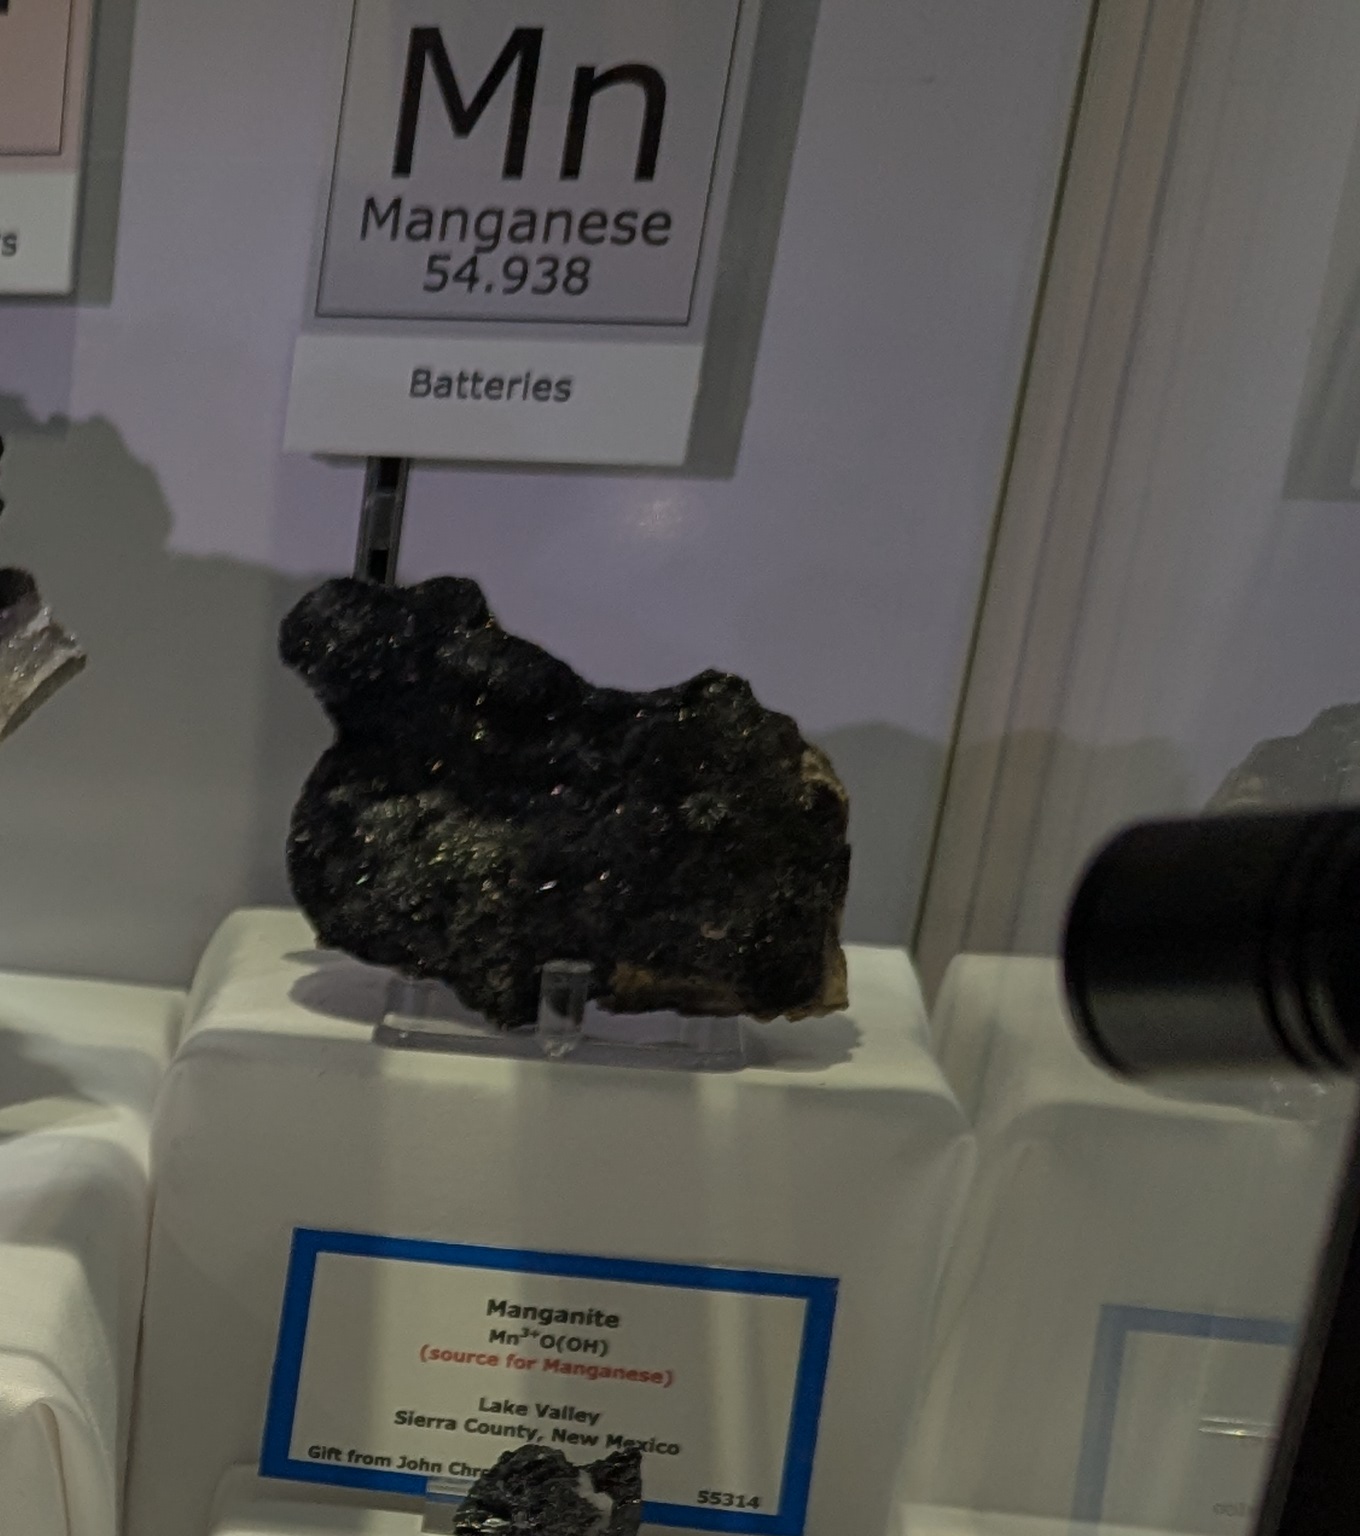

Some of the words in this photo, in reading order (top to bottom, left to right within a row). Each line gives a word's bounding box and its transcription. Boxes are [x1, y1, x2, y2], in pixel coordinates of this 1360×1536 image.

[392, 26, 667, 183] Mn
[360, 195, 673, 255] Manganese
[422, 251, 592, 296] 54.938
[409, 367, 573, 403] Batteries
[486, 1298, 620, 1329] Manganite
[419, 1343, 500, 1367] (source
[505, 1352, 538, 1370] for
[542, 1358, 673, 1388] Manganese)
[393, 1409, 458, 1431] Sierra
[463, 1417, 544, 1443] County,
[550, 1427, 600, 1447] New
[478, 1396, 529, 1417] Lake
[534, 1402, 601, 1427] Valley
[307, 1444, 343, 1462] Gift
[346, 1448, 392, 1467] from
[395, 1454, 443, 1474] John
